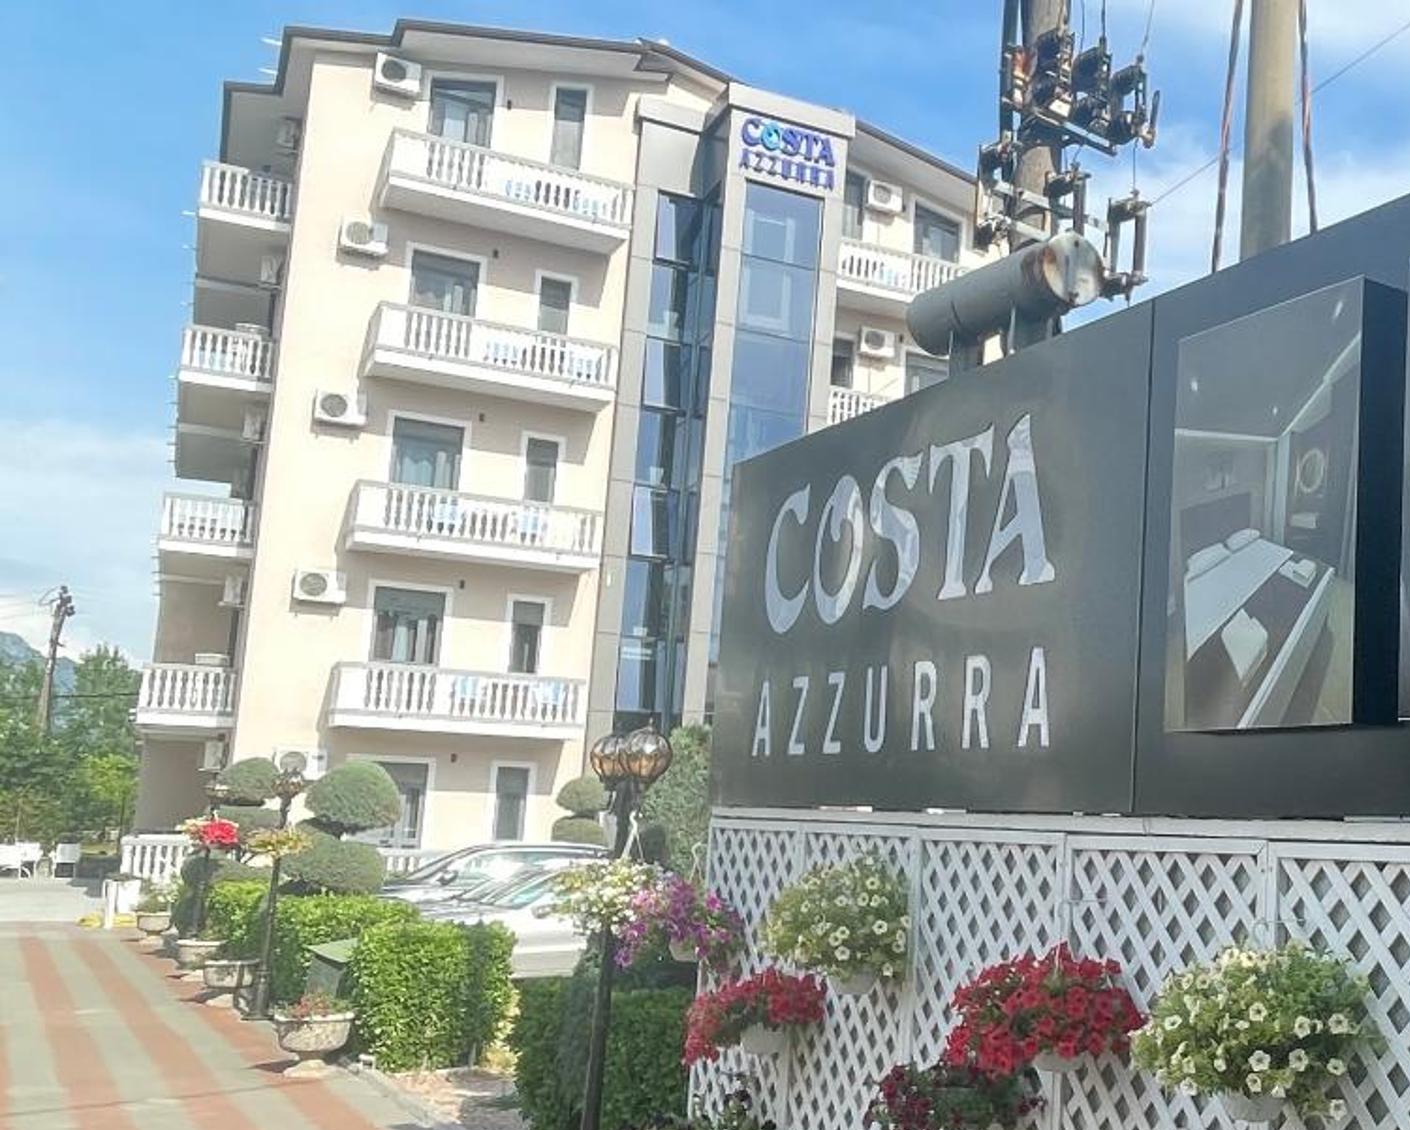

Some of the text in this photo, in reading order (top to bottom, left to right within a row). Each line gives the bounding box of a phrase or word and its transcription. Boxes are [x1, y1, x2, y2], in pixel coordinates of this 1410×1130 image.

[742, 118, 835, 168] COSTA
[765, 413, 1056, 635] COSTA
[751, 646, 1050, 758] AZZURRA
